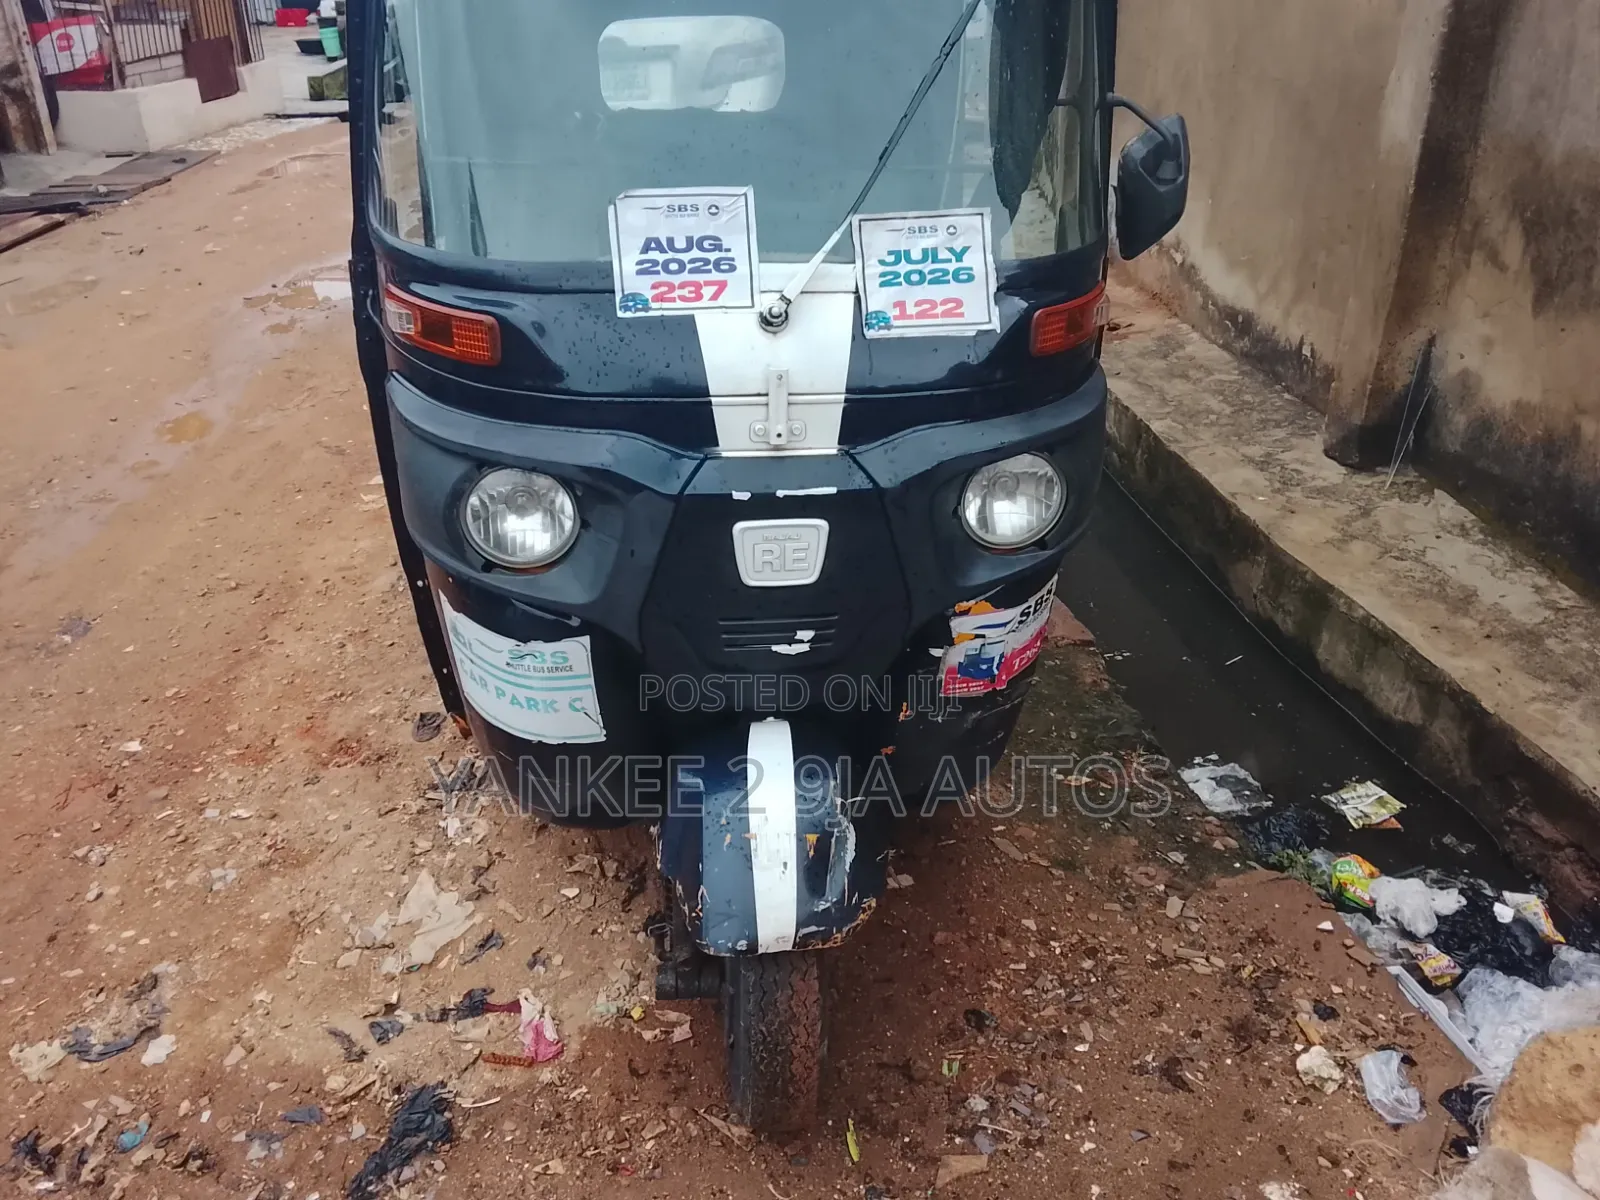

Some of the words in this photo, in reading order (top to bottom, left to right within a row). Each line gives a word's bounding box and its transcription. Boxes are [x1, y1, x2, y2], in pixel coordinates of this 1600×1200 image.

[666, 204, 700, 213] SBS
[907, 225, 939, 235] SBS
[638, 234, 732, 255] AUG.
[635, 256, 738, 276] 2026
[877, 245, 972, 267] JULY
[878, 266, 976, 288] 2026
[650, 279, 728, 303] 237
[892, 297, 965, 321] 122
[753, 542, 809, 573] RE
[533, 664, 546, 674] BUS
[546, 664, 574, 673] SERVICE
[459, 658, 490, 693] CAR
[494, 685, 560, 714] PARK
